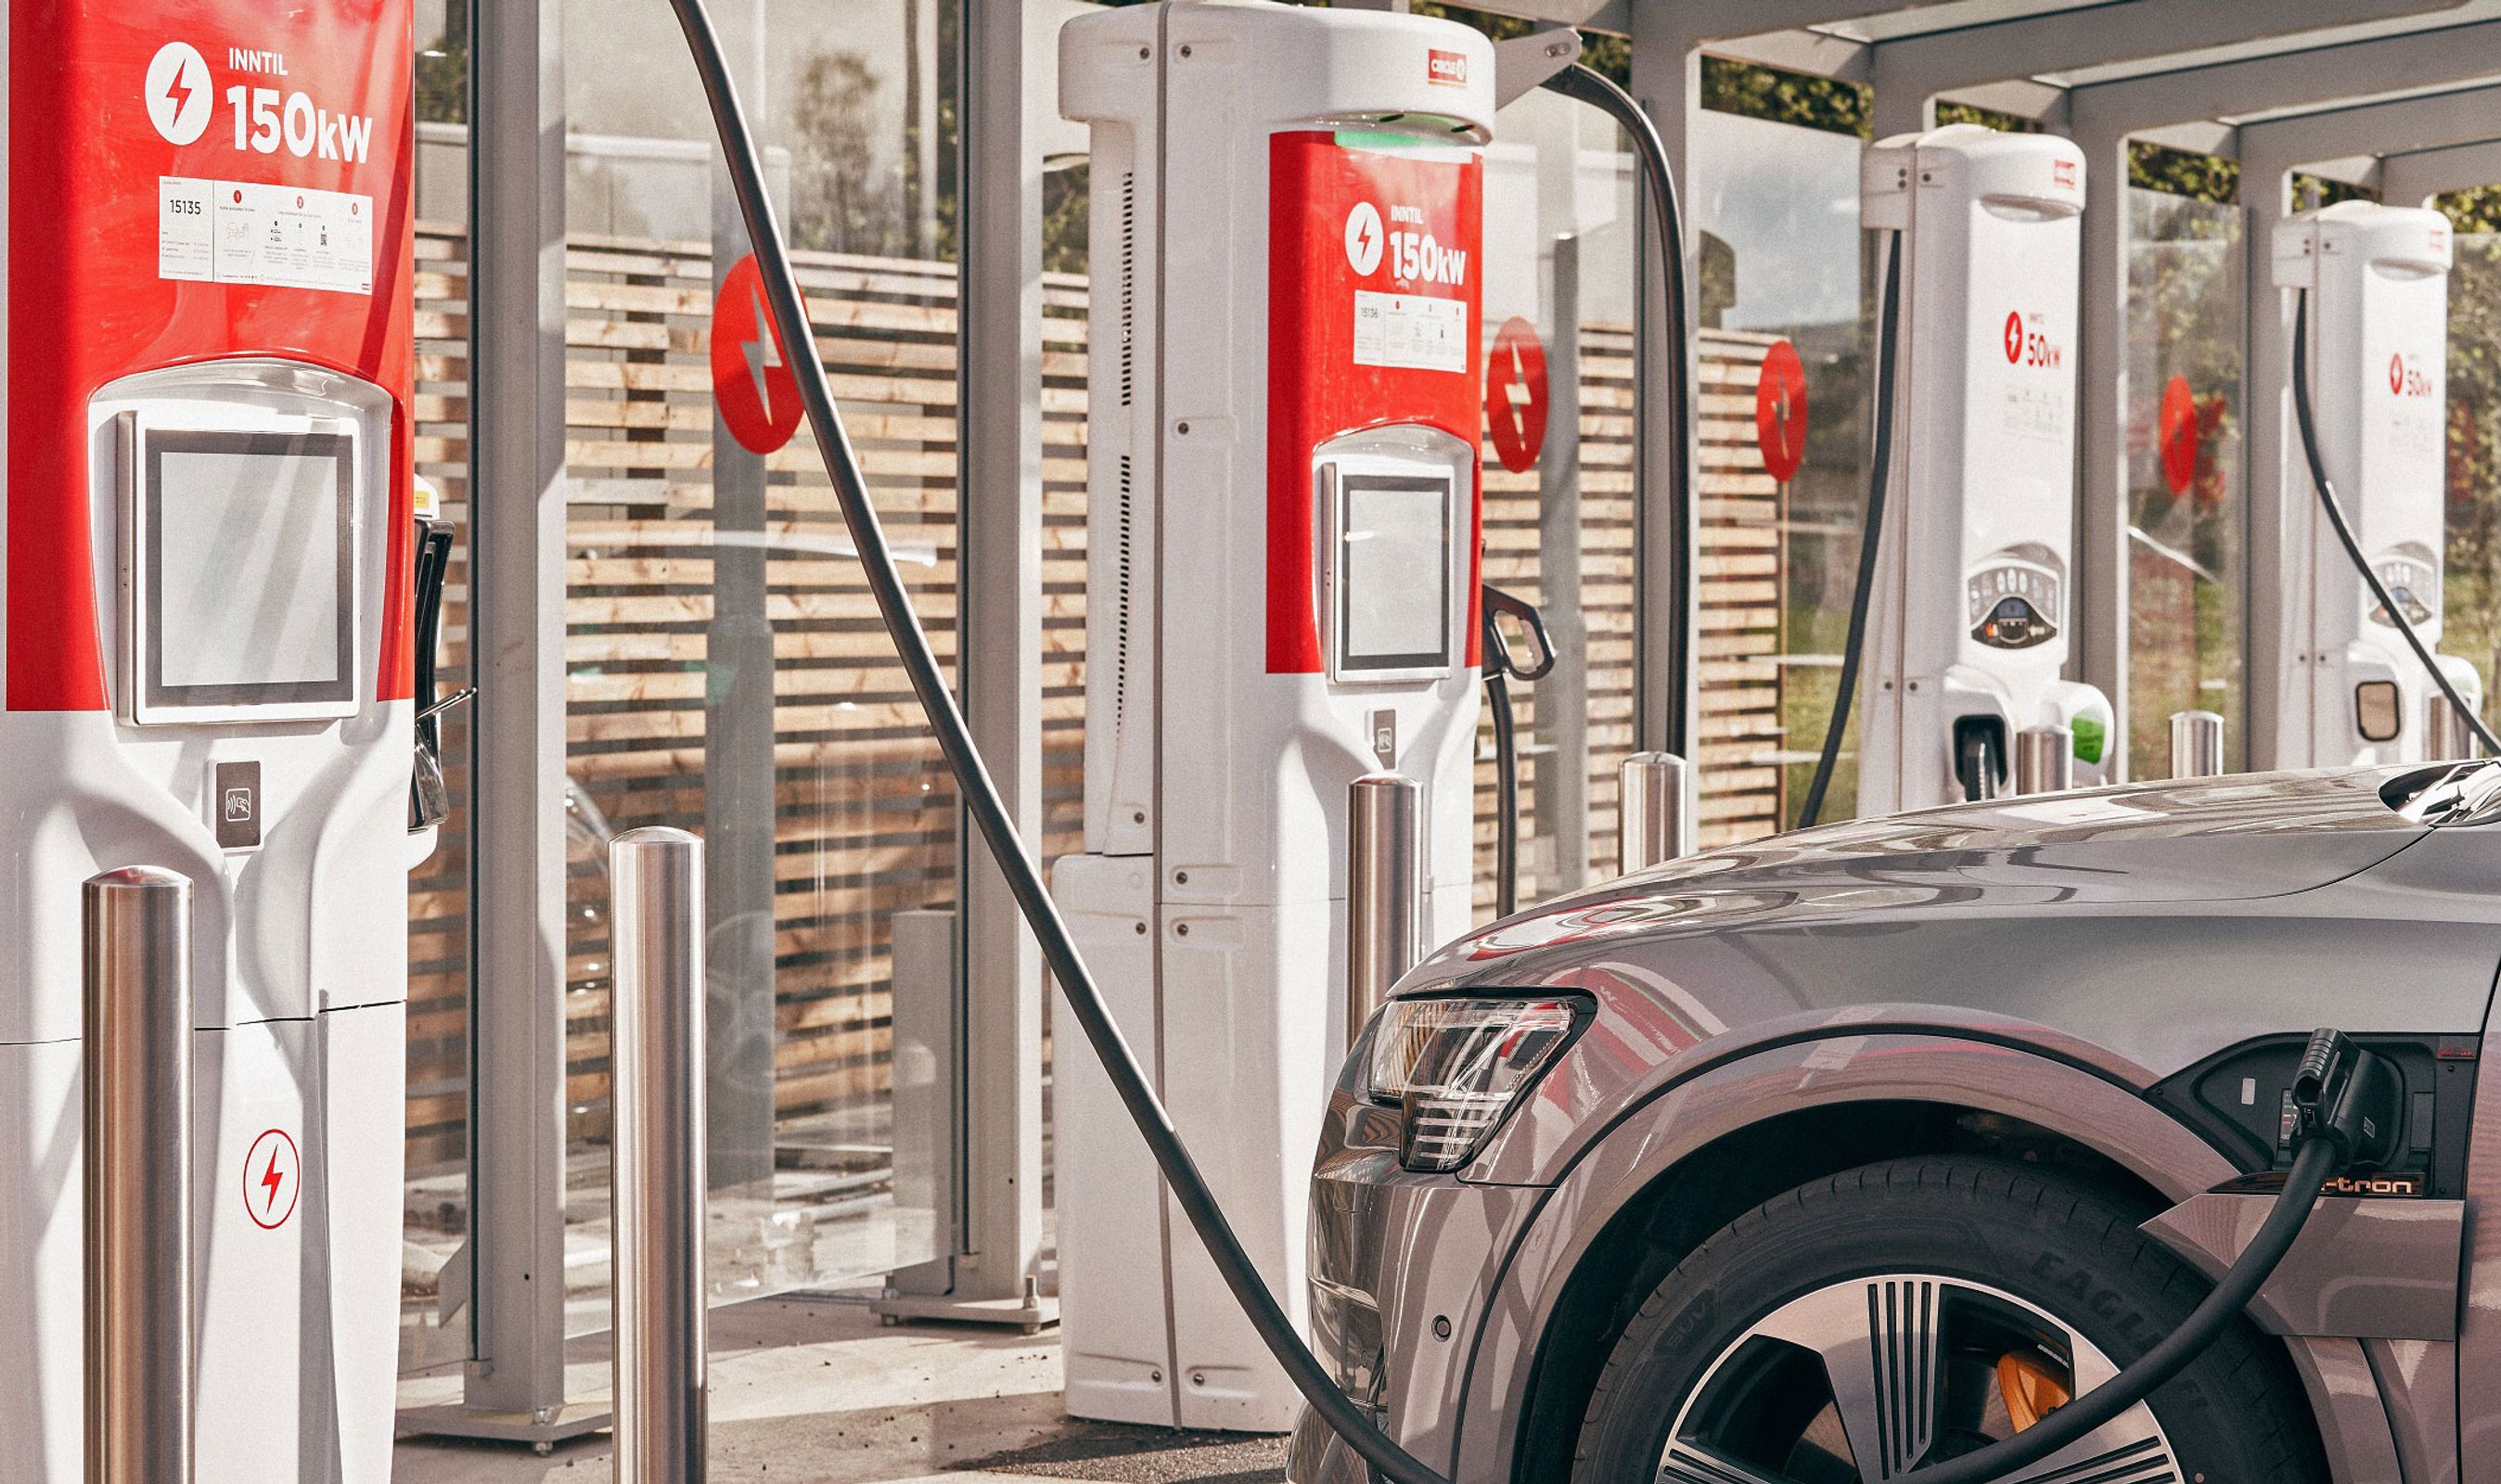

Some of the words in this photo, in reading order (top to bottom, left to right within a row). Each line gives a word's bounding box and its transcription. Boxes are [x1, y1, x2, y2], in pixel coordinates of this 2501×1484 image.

[228, 47, 289, 76] INNTIL
[226, 84, 373, 164] 150kW
[170, 198, 201, 215] 15135
[1391, 205, 1423, 224] INNTIL
[1390, 231, 1467, 287] 150kW
